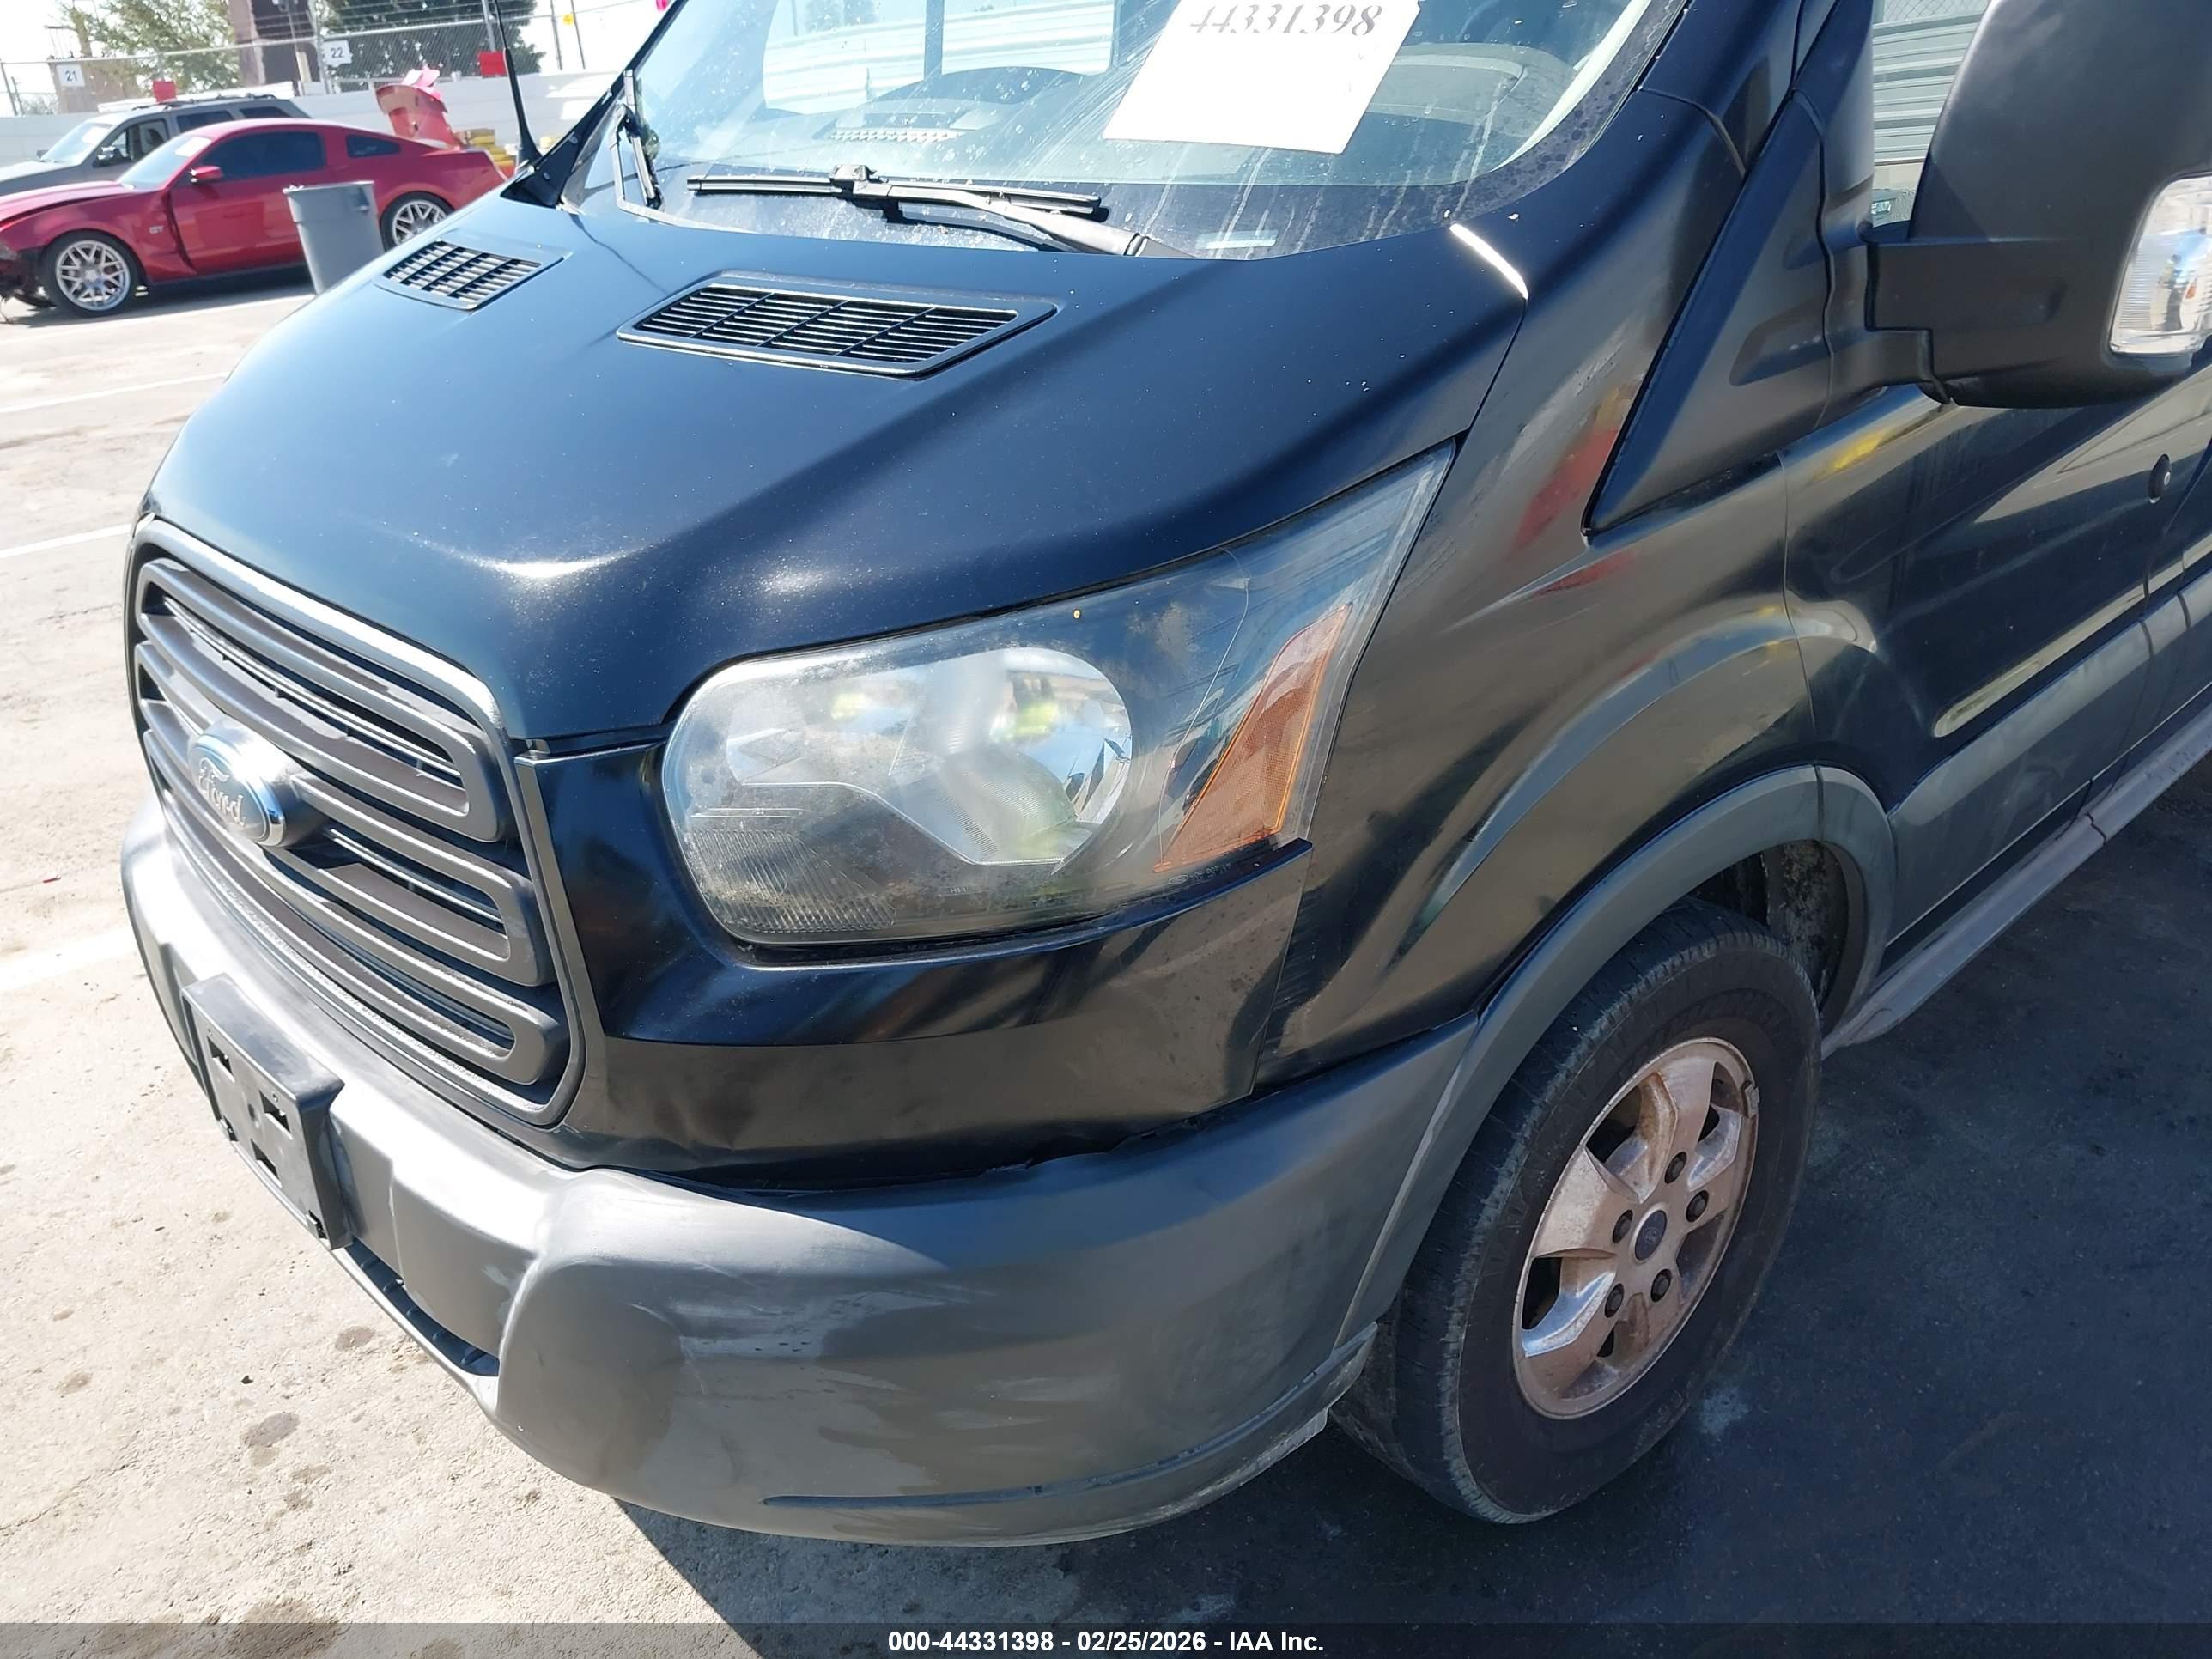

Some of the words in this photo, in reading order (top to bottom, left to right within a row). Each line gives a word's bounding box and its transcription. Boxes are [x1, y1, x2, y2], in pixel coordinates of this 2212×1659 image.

[1189, 3, 1383, 36] 44331398
[330, 46, 344, 58] 22
[64, 70, 77, 82] 21
[198, 757, 247, 827] Ford
